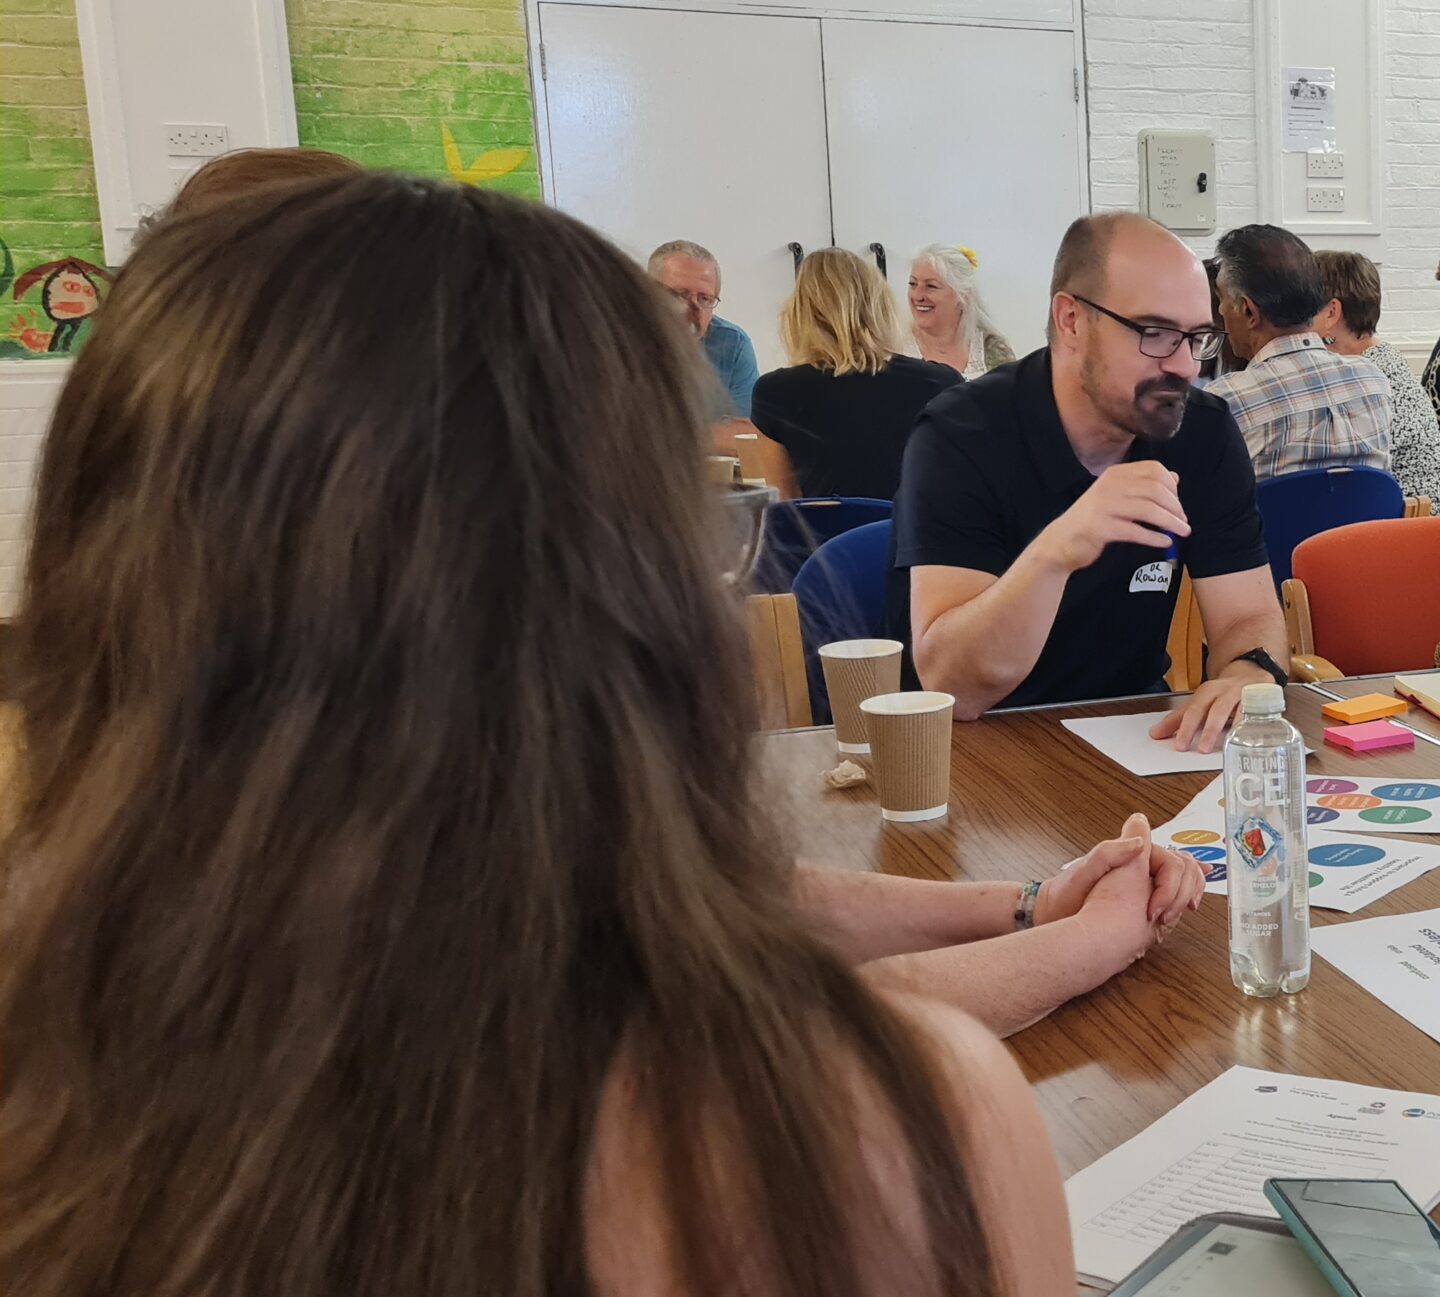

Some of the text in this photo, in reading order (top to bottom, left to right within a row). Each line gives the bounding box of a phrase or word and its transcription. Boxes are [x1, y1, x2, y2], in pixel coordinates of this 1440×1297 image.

[1252, 923, 1279, 931] ADDED
[1246, 929, 1272, 937] SUGAR
[1398, 960, 1430, 980] confused
